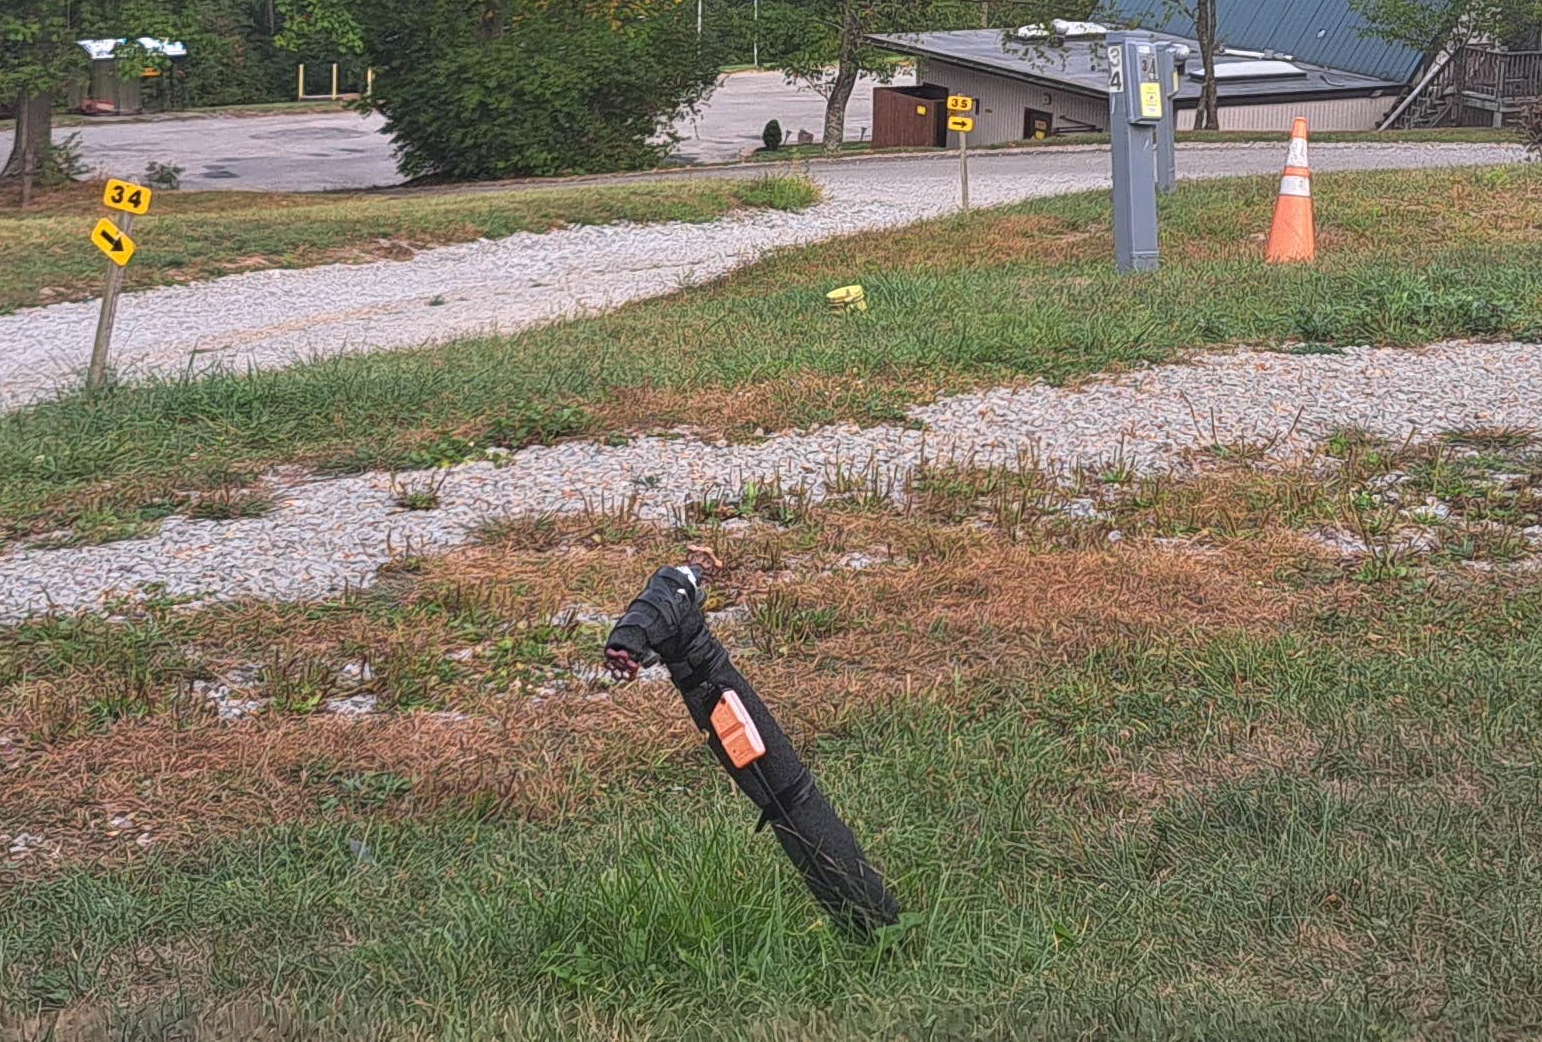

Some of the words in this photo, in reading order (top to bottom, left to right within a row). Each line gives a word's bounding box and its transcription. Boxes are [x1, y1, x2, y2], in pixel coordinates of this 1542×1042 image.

[1141, 58, 1156, 76] 34
[950, 98, 968, 109] 35
[110, 184, 143, 209] 34
